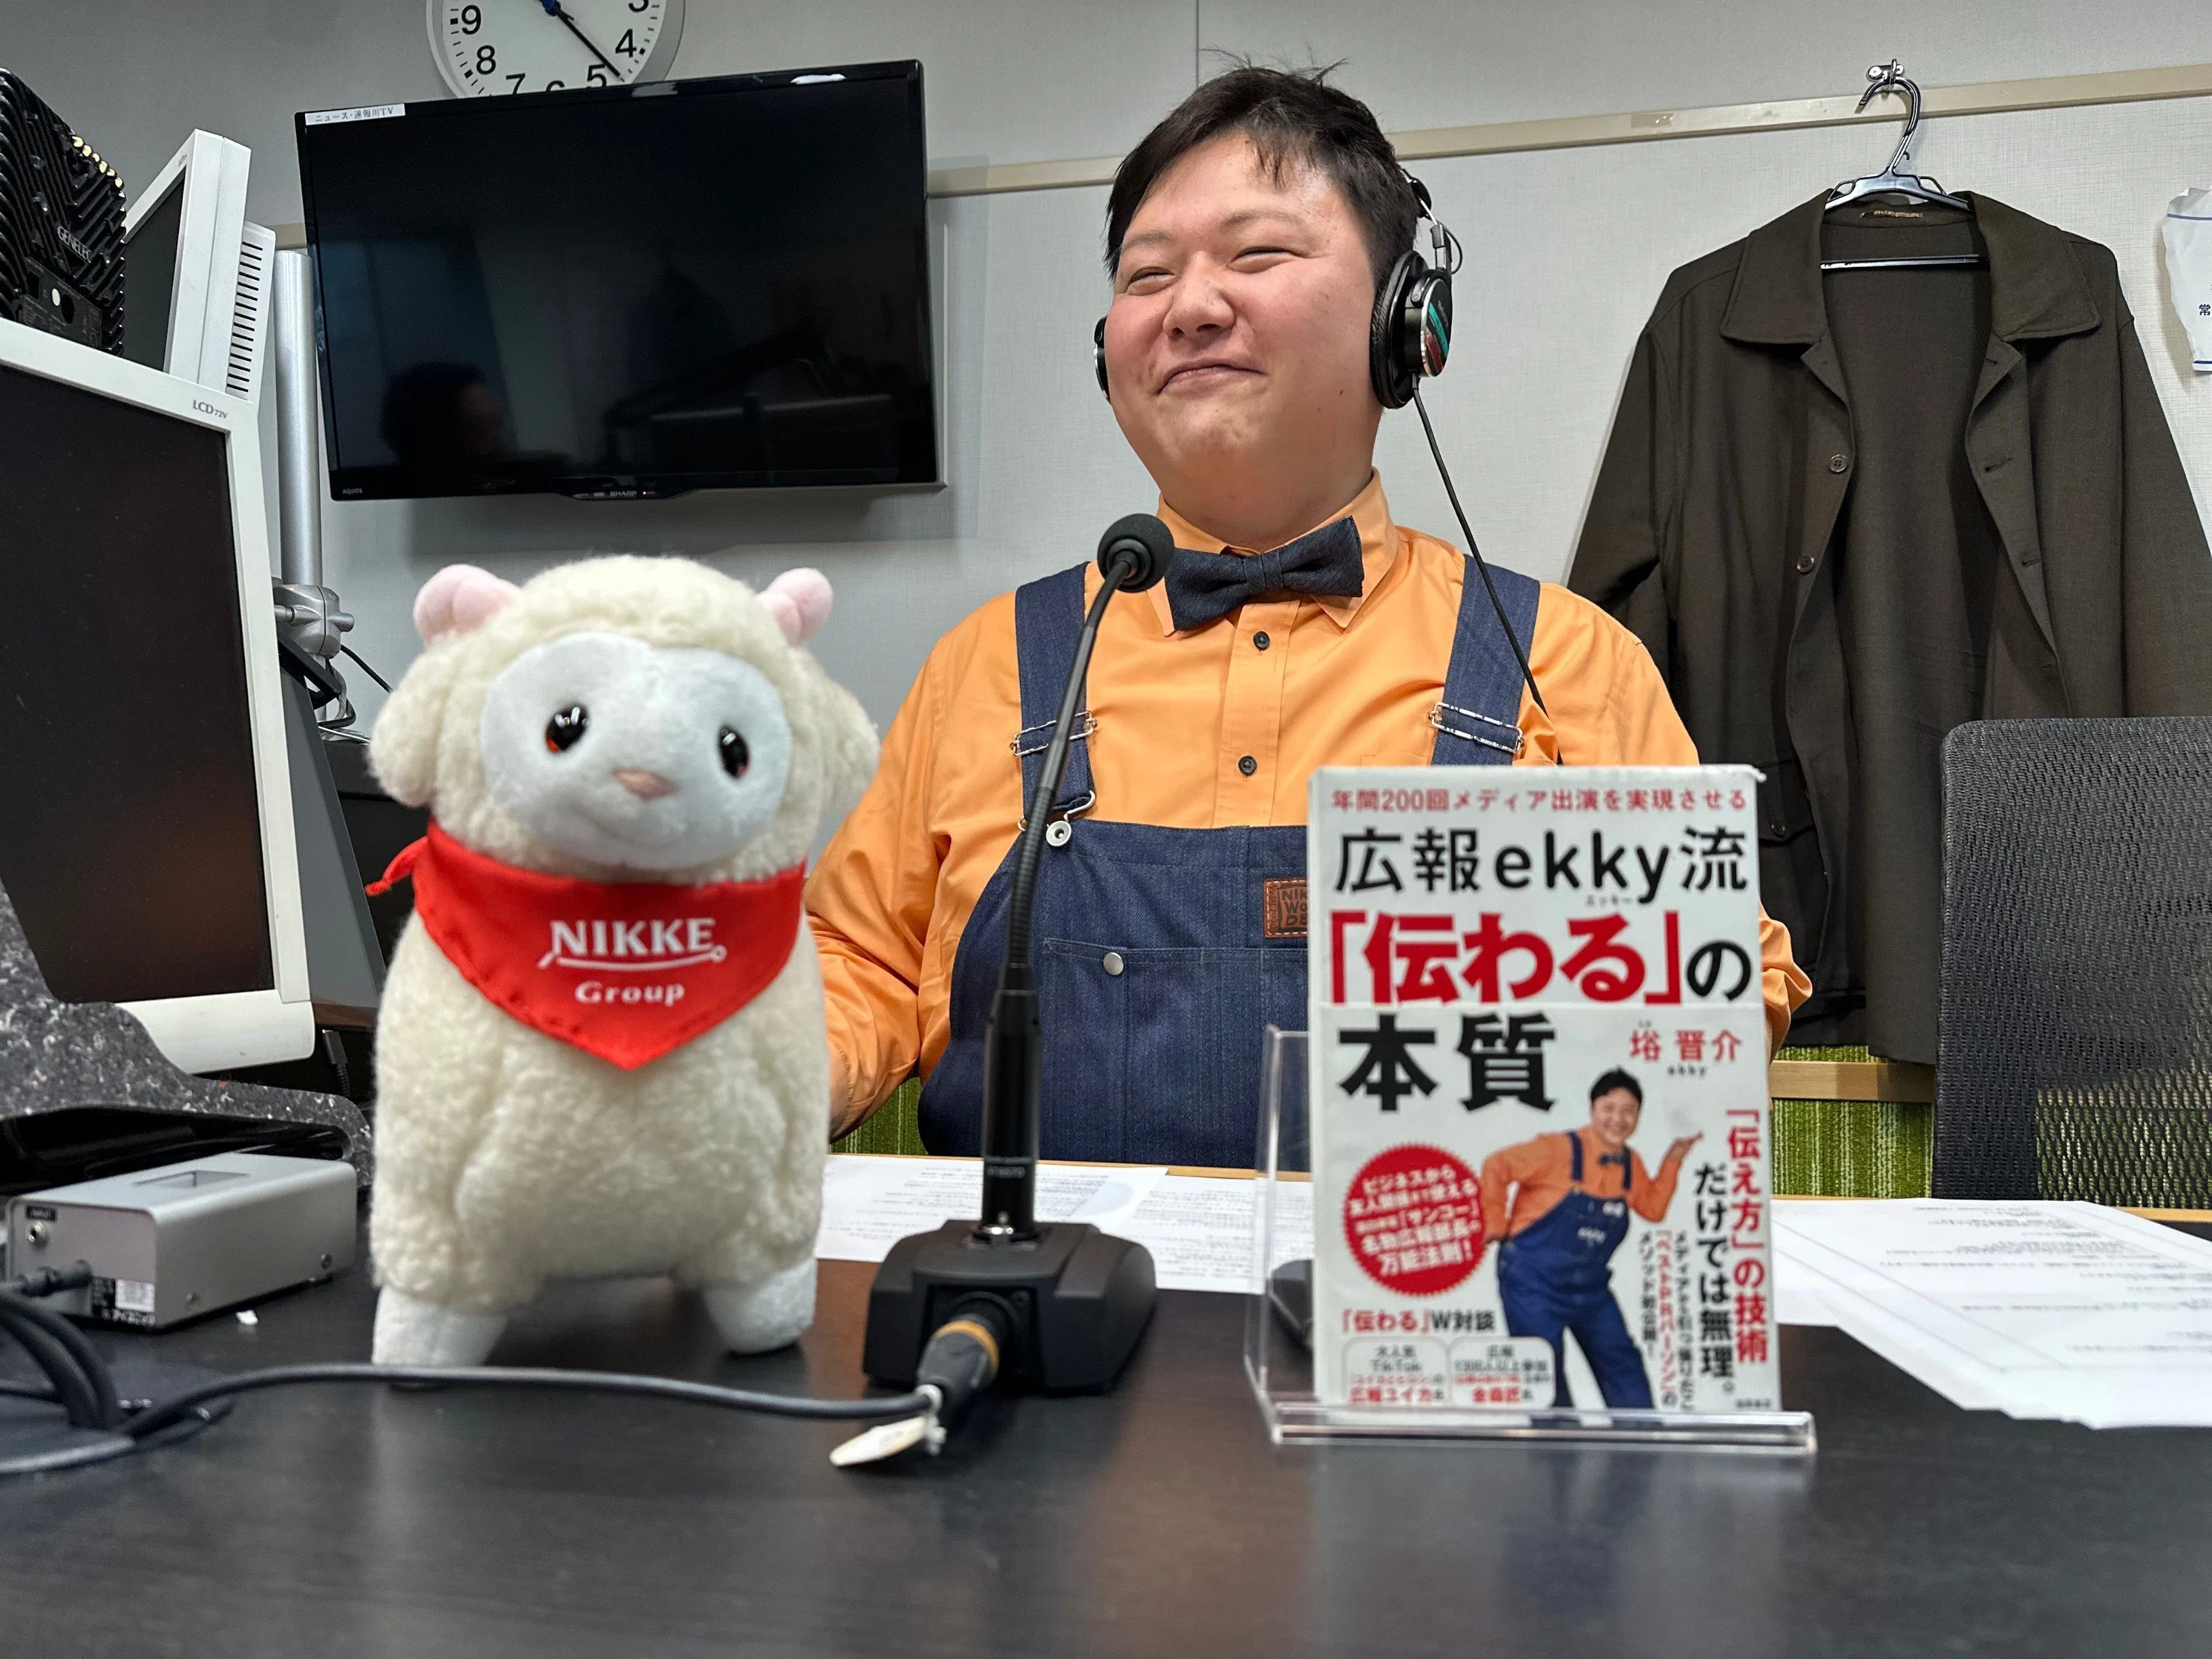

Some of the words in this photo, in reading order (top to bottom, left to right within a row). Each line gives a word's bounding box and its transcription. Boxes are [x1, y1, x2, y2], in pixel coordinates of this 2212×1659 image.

[462, 4, 482, 35] 9
[615, 28, 637, 58] 4
[476, 45, 496, 75] 8
[506, 73, 526, 95] 7
[586, 64, 608, 88] 5
[315, 106, 394, 123] ニュース・速報用TV
[57, 226, 92, 264] GENELEC
[1331, 787, 1746, 812] 年間200回メディア出演を実現させる
[1335, 825, 1748, 905] 広報ekky流
[549, 917, 716, 957] NIKKE
[1329, 910, 1753, 1006] 「伝わる」の
[575, 981, 685, 1007] Group
[1337, 1011, 1558, 1112] 本質
[1726, 1109, 1769, 1363] 「伝え方」の技術
[1694, 1162, 1735, 1393] だけでは無理。
